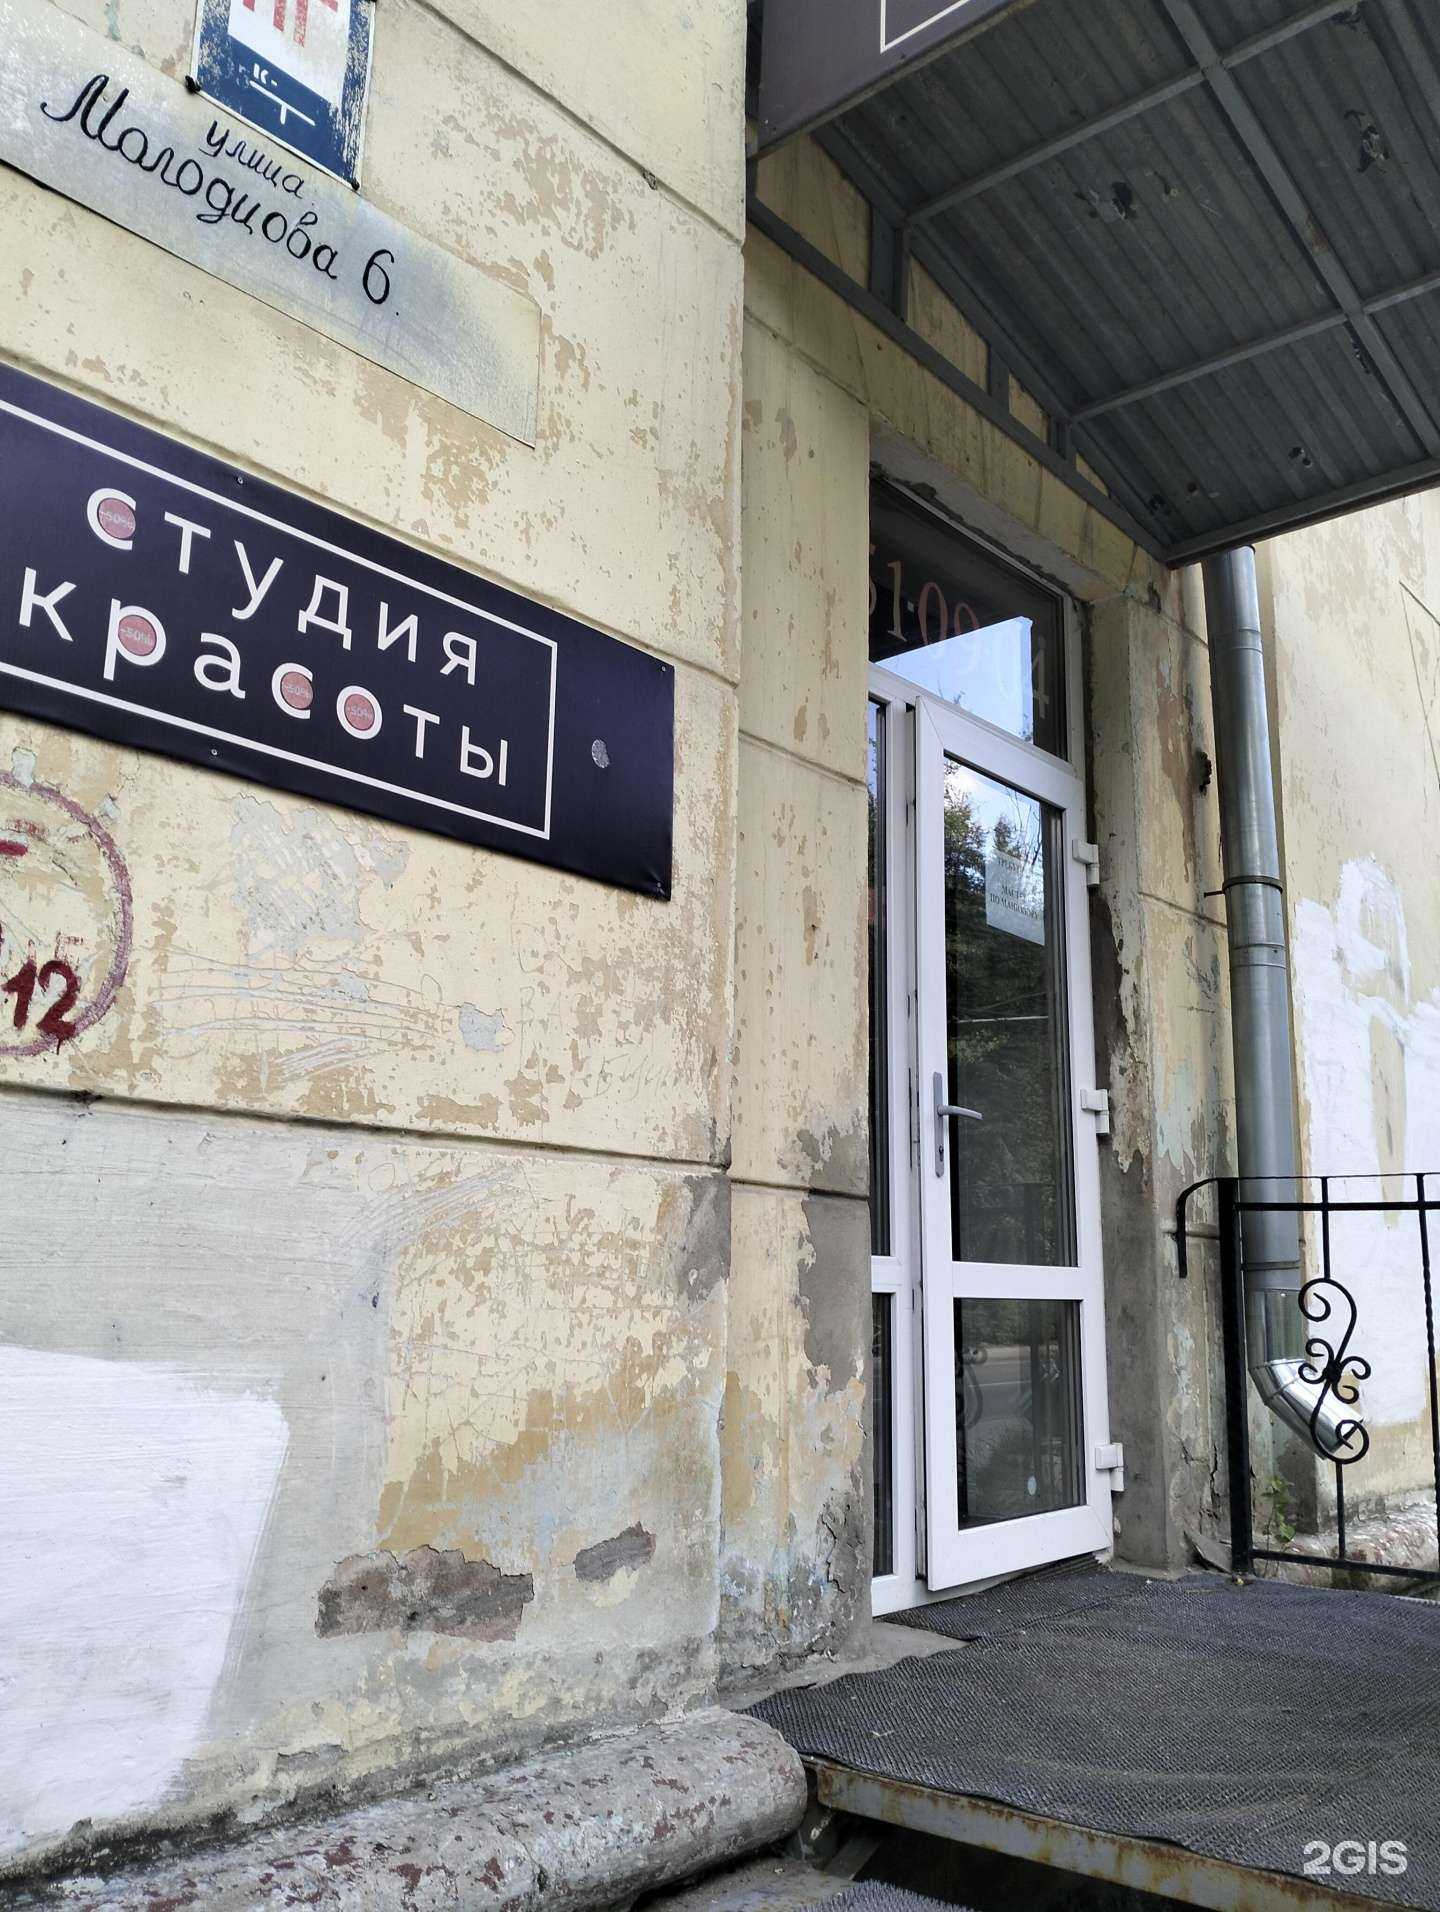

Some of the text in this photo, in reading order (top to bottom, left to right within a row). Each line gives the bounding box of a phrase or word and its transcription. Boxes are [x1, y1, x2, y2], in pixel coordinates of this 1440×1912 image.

[40, 74, 395, 305] Молодцова 6
[198, 120, 305, 200] улица
[19, 566, 508, 787] красоты
[87, 487, 478, 686] студия
[1, 958, 79, 1041] 12
